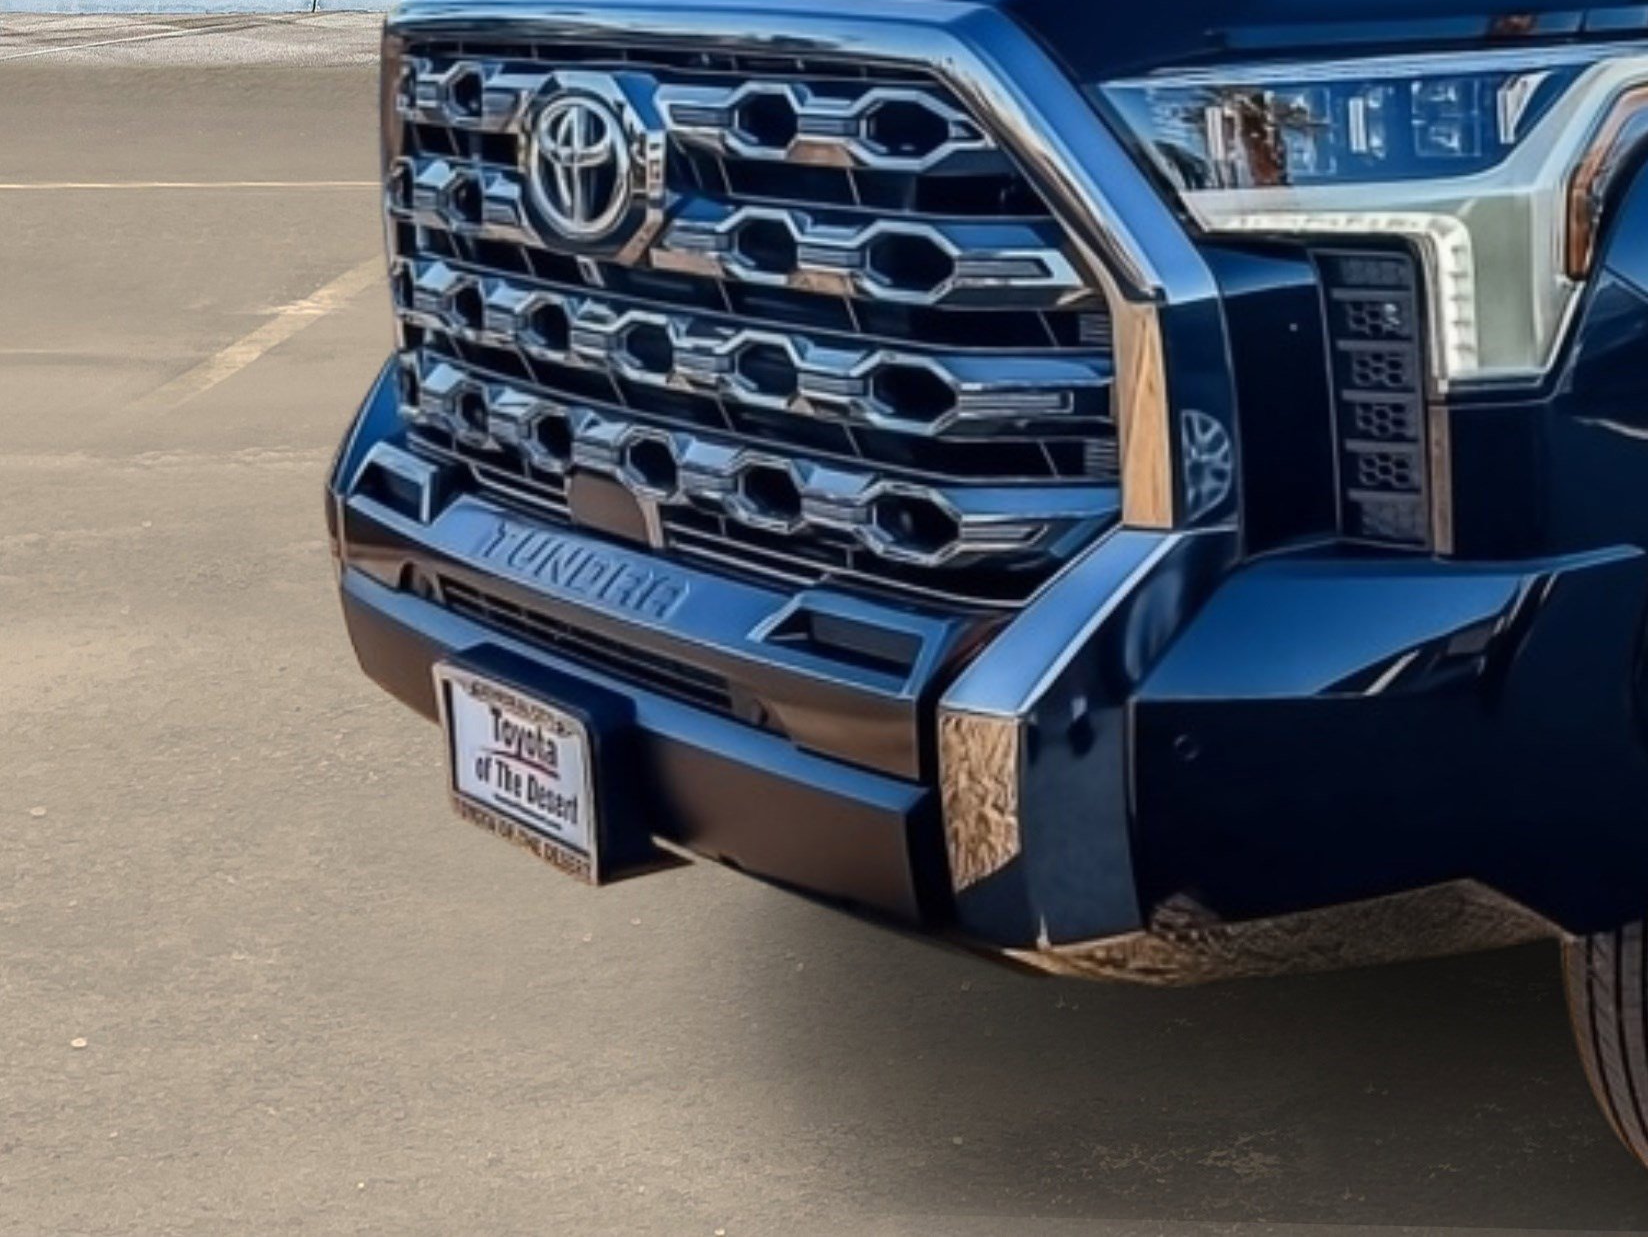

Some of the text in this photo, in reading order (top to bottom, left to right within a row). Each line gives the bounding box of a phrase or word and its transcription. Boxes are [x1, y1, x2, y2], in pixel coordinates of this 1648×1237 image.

[490, 705, 560, 767] Toyota
[475, 756, 492, 783] of
[494, 760, 523, 798] The
[527, 774, 579, 825] Desert
